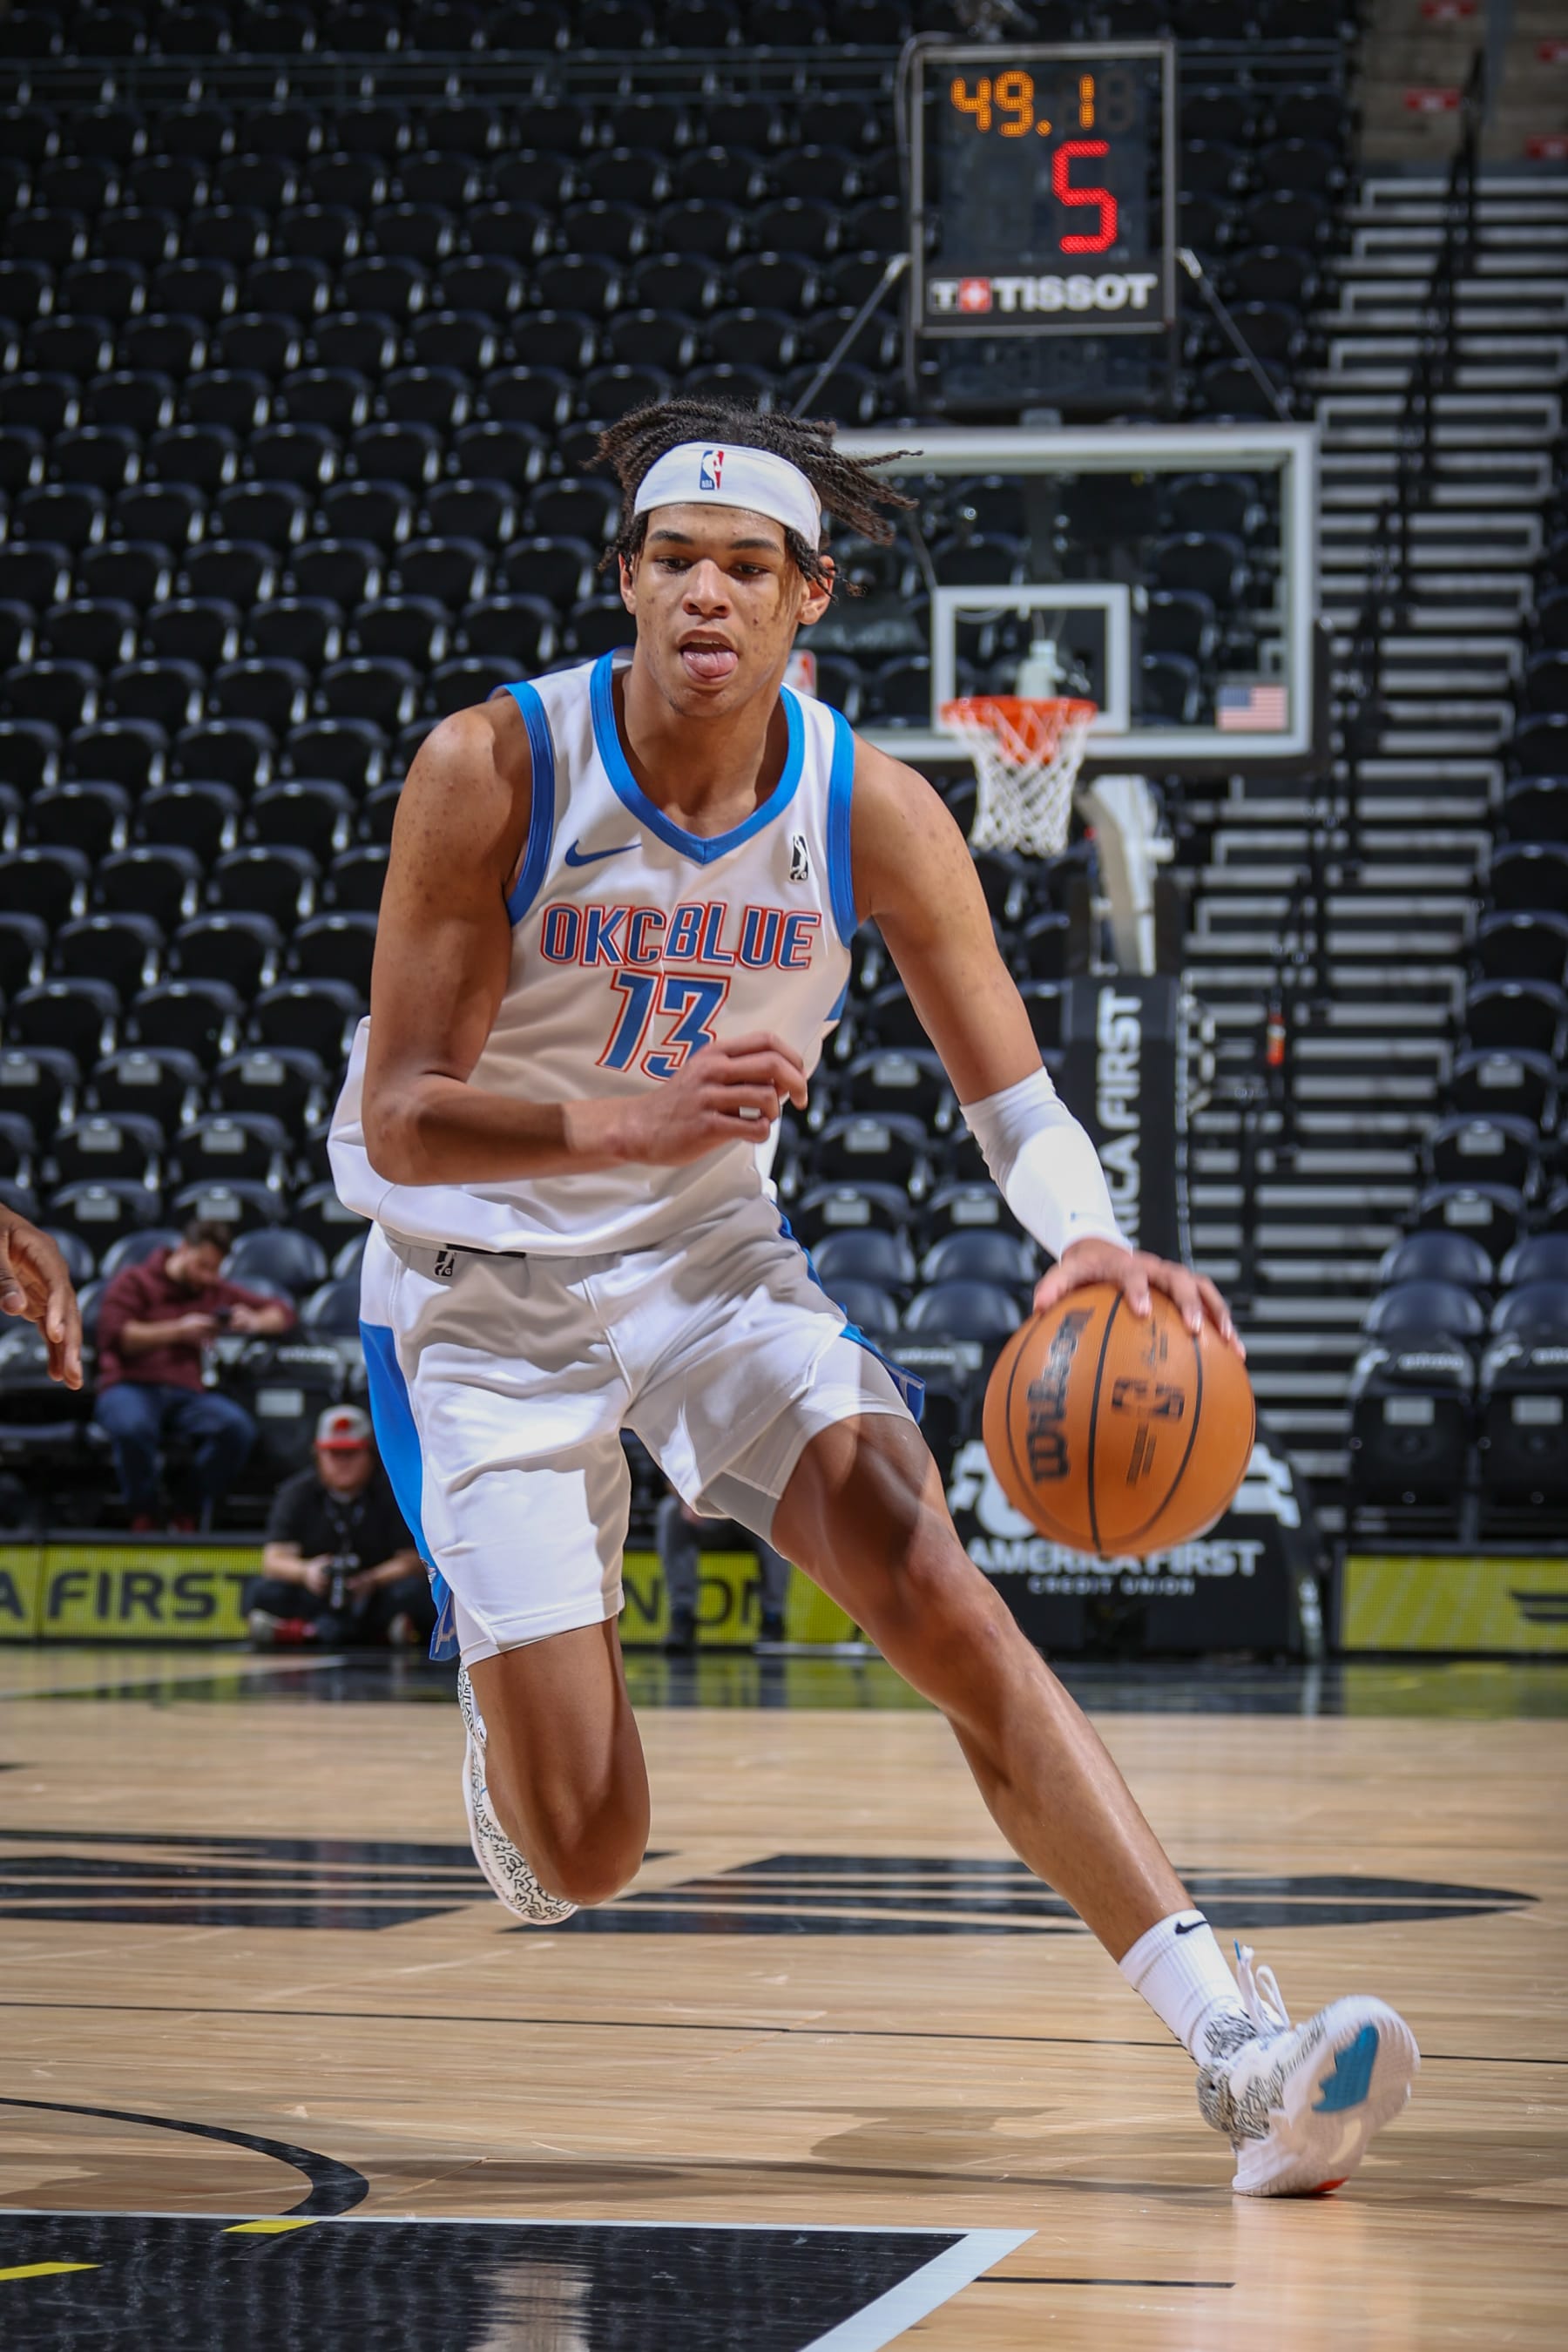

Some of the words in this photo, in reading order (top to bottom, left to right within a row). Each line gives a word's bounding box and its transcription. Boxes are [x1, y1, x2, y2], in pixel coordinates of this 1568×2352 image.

[1051, 139, 1118, 253] 5
[993, 274, 1159, 312] TISSOT
[594, 968, 731, 1083] 13
[1096, 985, 1142, 1131] FIRST
[1028, 1575, 1112, 1595] CREDIT
[1120, 1575, 1196, 1596] UNION
[1146, 1539, 1266, 1577] FIRST
